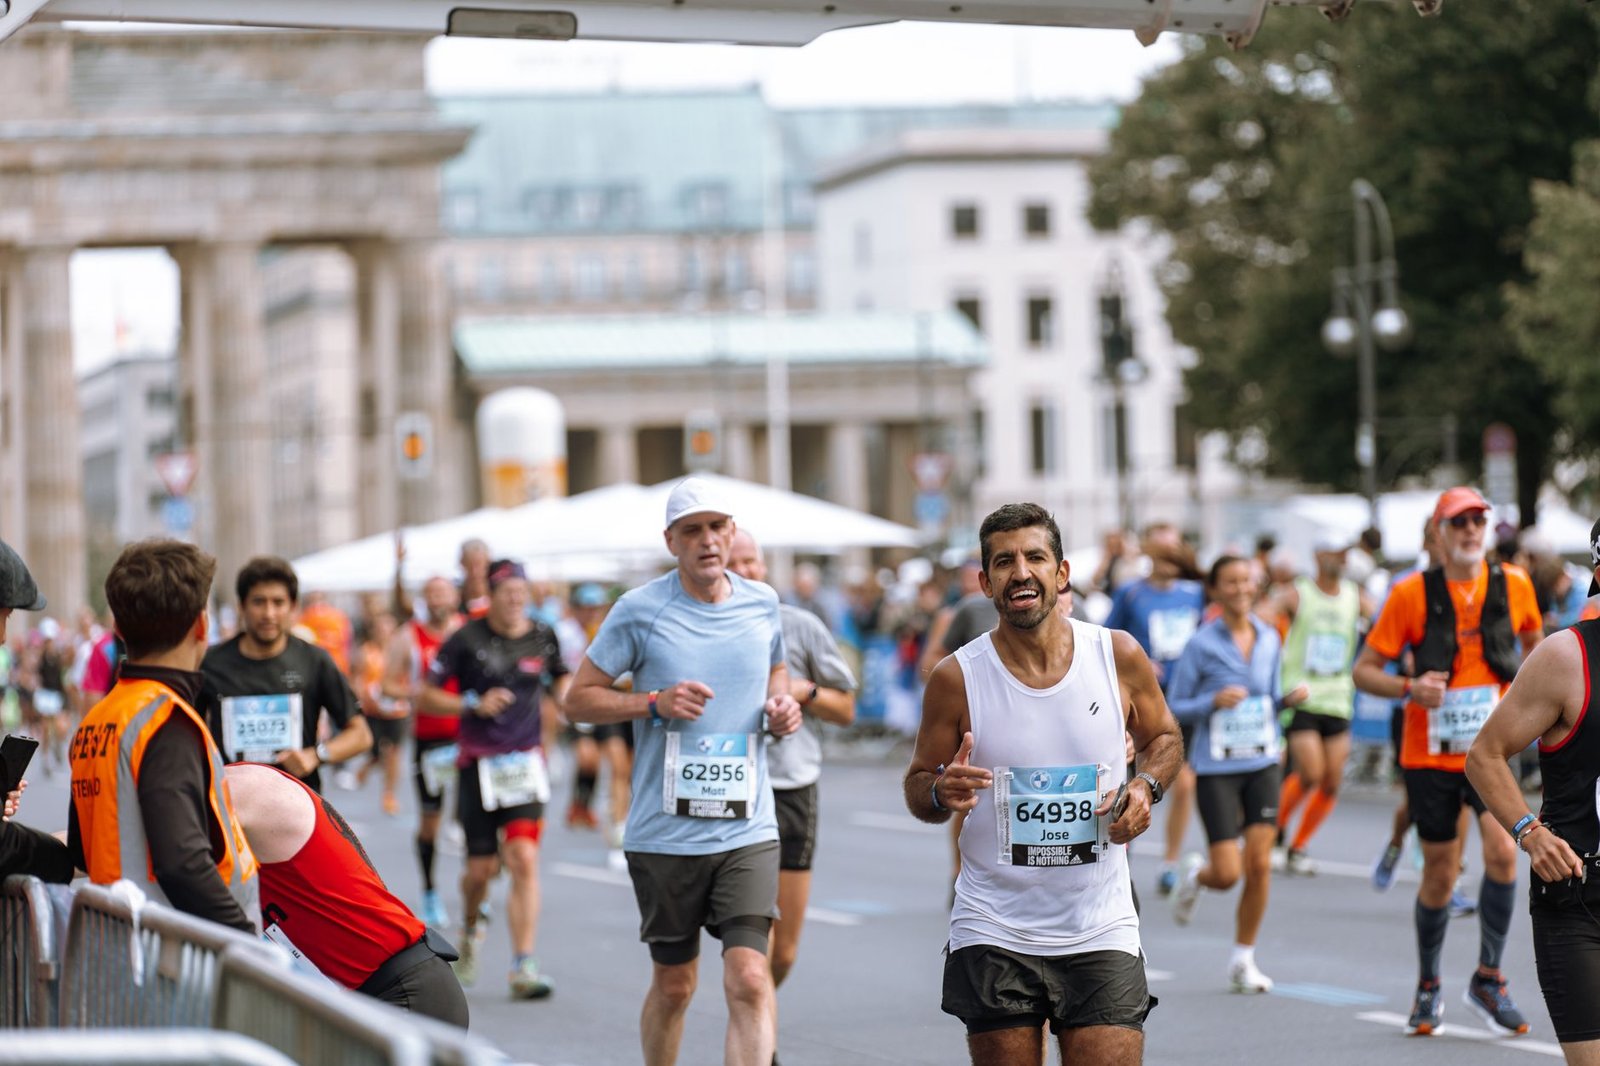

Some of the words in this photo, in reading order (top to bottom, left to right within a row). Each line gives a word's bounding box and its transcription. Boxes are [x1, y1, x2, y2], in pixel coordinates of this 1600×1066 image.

[682, 763, 744, 782] 62956
[701, 786, 727, 796] Matt
[1016, 800, 1093, 824] 64938
[1040, 829, 1070, 842] Jose
[1027, 845, 1072, 857] IMPOSSIBLE
[1027, 855, 1036, 866] IS
[1036, 855, 1070, 866] NOTHING
